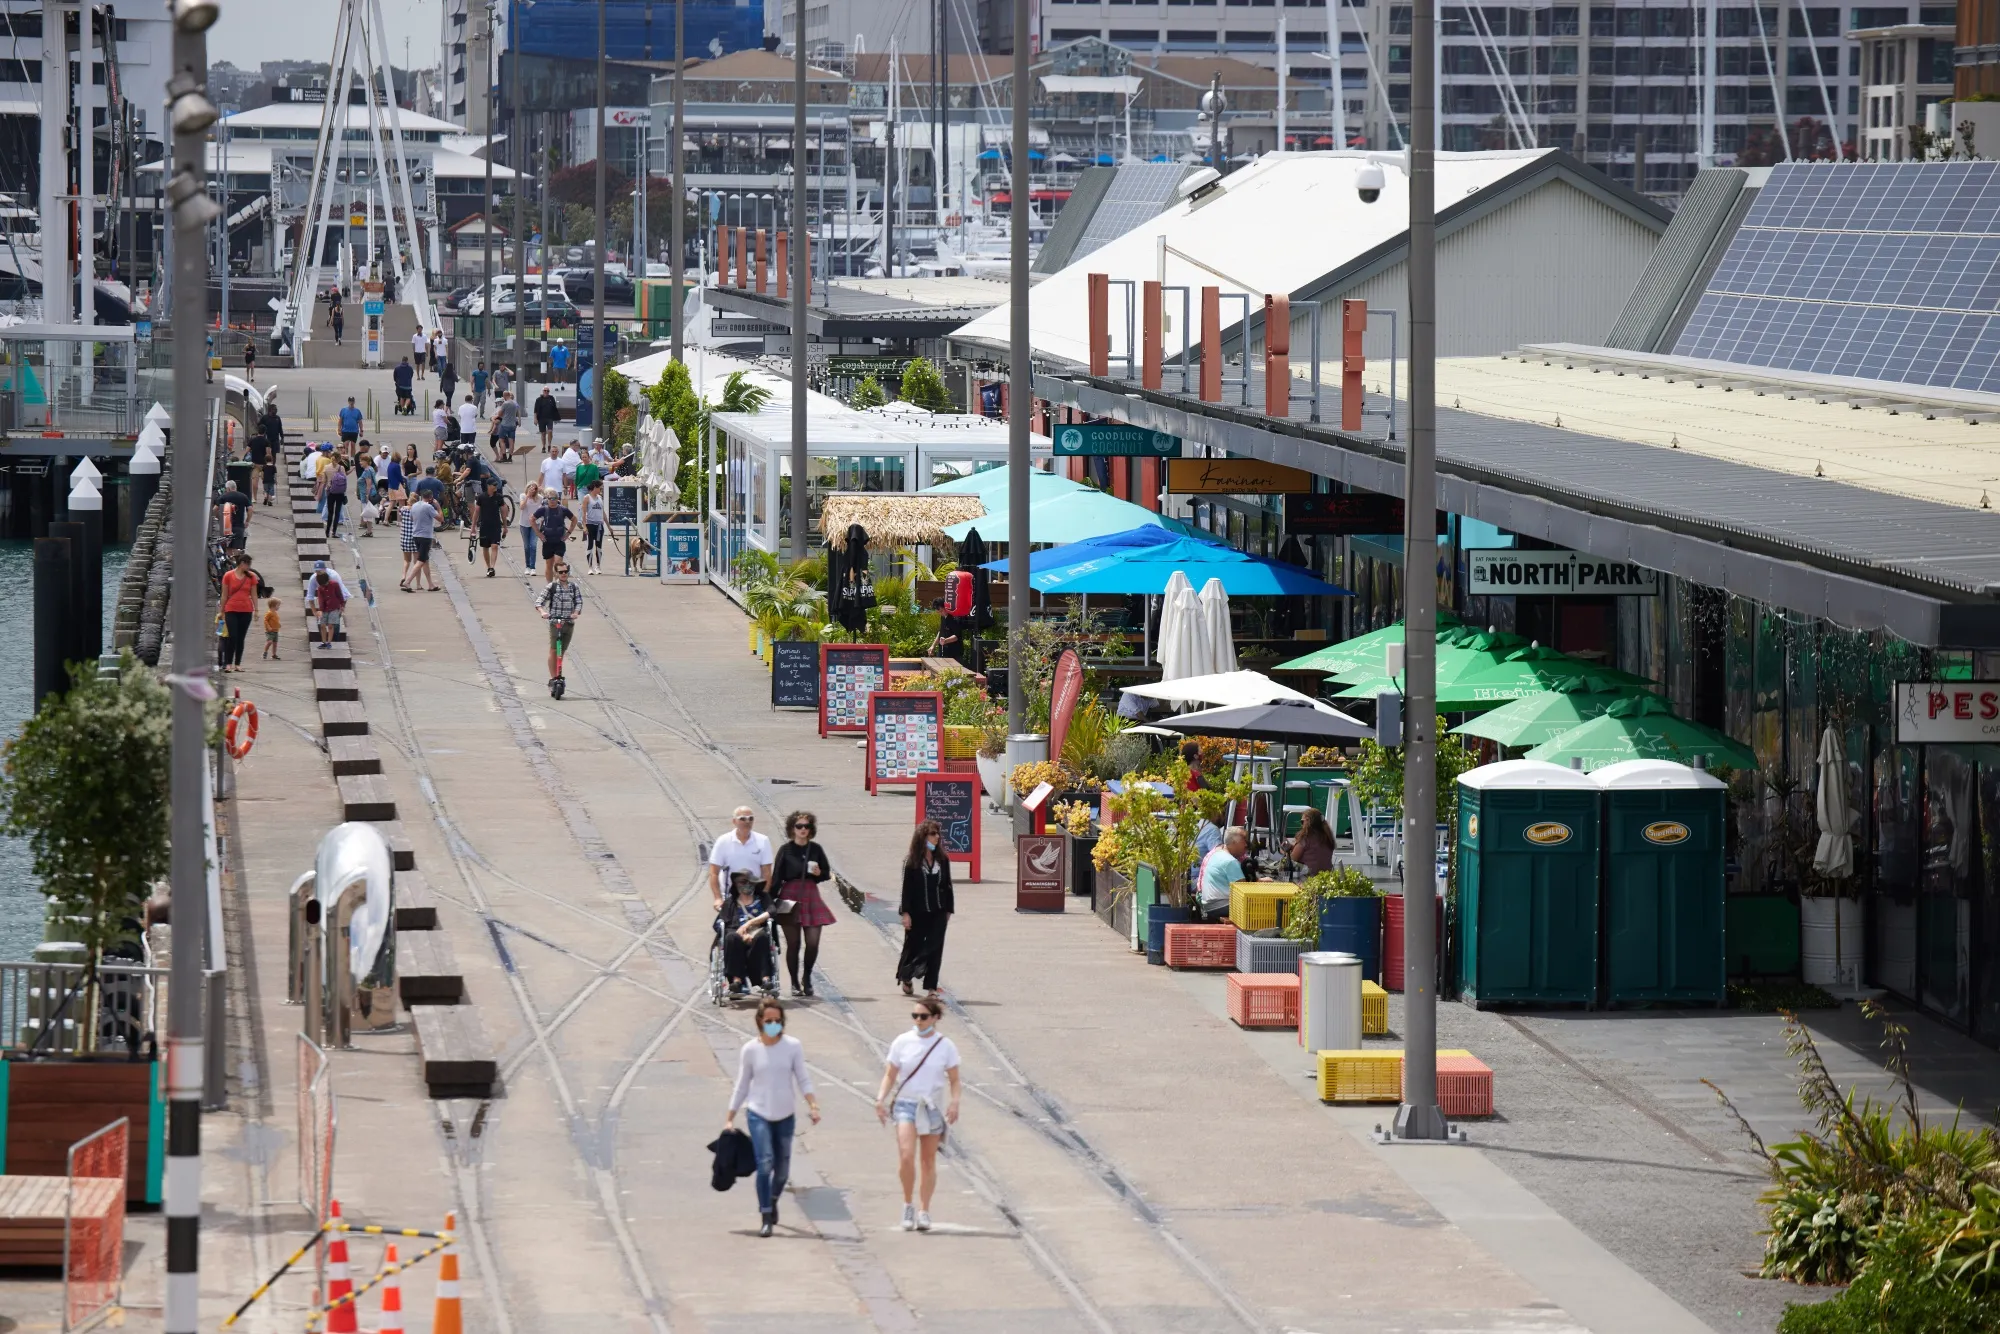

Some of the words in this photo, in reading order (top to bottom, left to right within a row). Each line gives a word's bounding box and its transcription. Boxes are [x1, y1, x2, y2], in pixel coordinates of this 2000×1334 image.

[730, 324, 746, 332] GOOD
[746, 324, 771, 332] GEORGE
[841, 361, 896, 371] conservatory
[1091, 431, 1144, 440] GOODLUCK
[1091, 441, 1144, 454] COCONUT
[1200, 462, 1275, 488] Kaminari
[1490, 563, 1569, 585] NORTH
[1578, 563, 1643, 585] PARK
